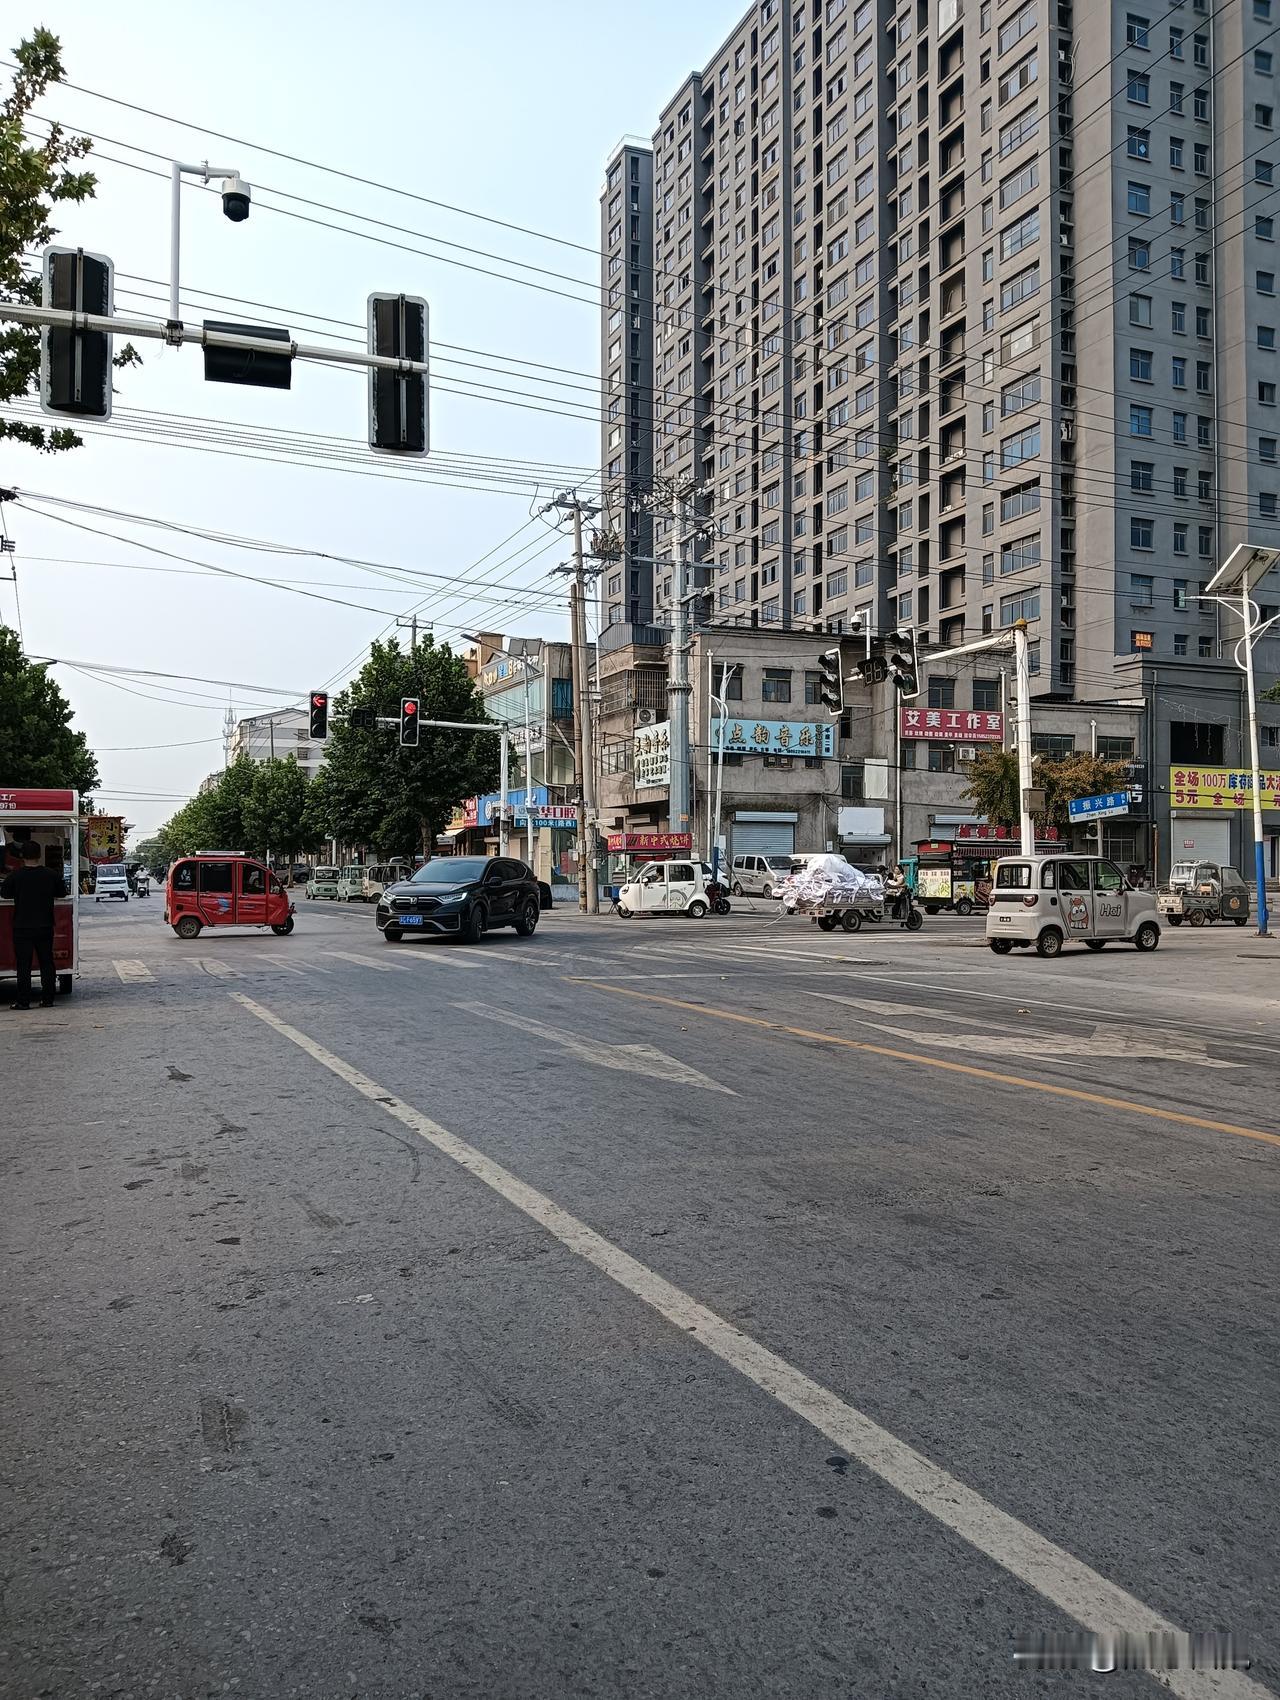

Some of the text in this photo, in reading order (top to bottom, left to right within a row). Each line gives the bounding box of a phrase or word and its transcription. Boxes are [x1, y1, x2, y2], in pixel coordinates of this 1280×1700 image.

[905, 710, 1001, 730] 艾美工作室
[1082, 796, 1115, 811] 振兴路
